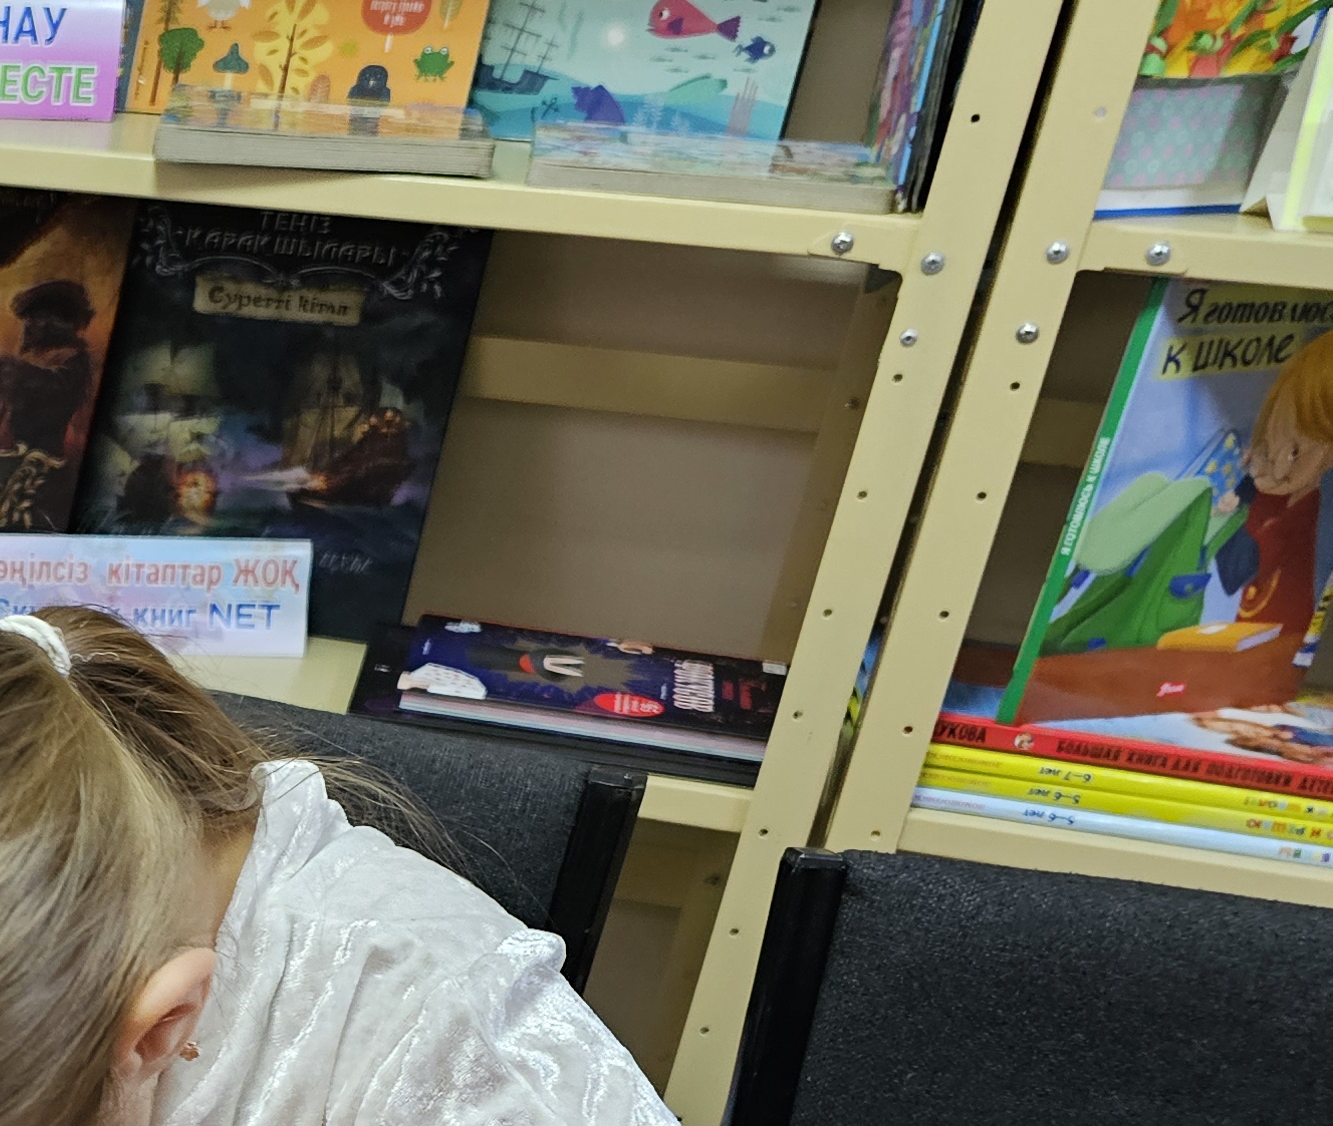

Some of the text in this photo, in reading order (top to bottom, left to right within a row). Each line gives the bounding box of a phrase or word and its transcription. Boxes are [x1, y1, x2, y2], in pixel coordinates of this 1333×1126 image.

[1177, 288, 1209, 323] Я
[107, 556, 222, 593] кітаптар
[233, 556, 301, 593] ЖОҚ
[208, 603, 281, 630] NET
